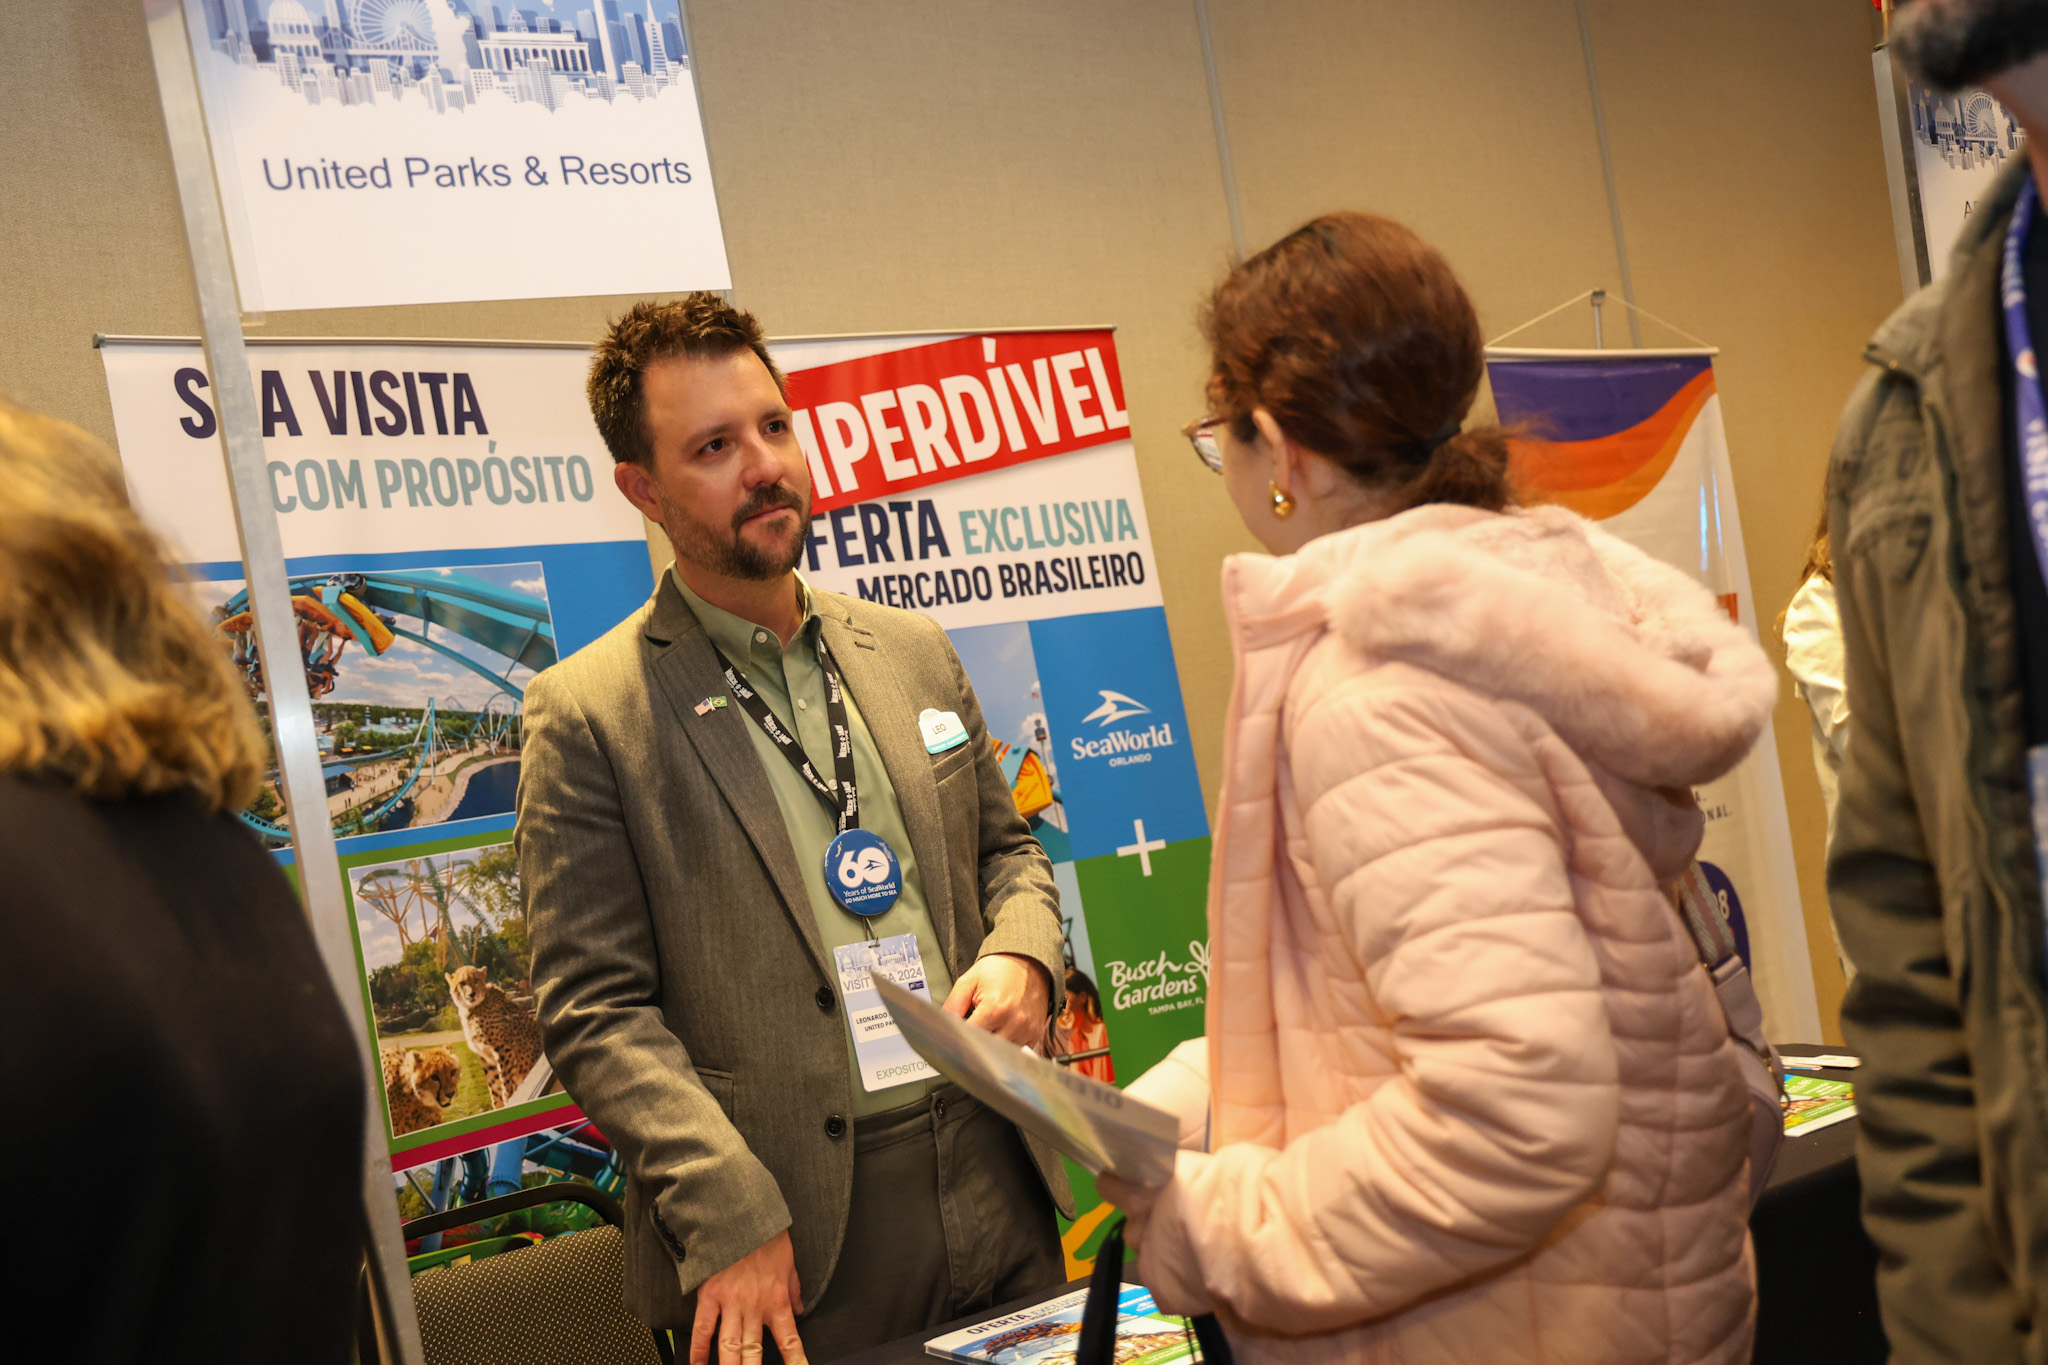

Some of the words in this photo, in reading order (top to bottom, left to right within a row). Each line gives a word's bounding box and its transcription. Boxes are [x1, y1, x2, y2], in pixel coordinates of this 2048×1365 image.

[262, 157, 392, 191] United
[404, 155, 512, 188] Parks
[524, 155, 549, 186] &
[559, 155, 692, 186] Resorts
[174, 367, 303, 439] SA
[307, 369, 489, 437] VISITA
[791, 336, 1130, 500] MPERDÍVEL
[266, 459, 368, 513] COM
[373, 439, 595, 509] PROPÓSITO
[803, 499, 952, 572] FERTA
[958, 498, 1139, 555] EXCLUSIVA
[856, 565, 993, 609] MERCADO
[997, 551, 1146, 599] BRASILEIRO
[931, 723, 947, 735] LEO
[1070, 722, 1175, 761] SeaWorld
[1108, 752, 1153, 768] ORLANDO
[837, 846, 891, 889] 60
[843, 889, 860, 898] Years
[860, 886, 868, 895] of
[867, 881, 896, 893] SeaWorld
[842, 976, 870, 992] VISIT
[897, 966, 923, 982] 2024
[1104, 950, 1184, 988] Busch
[1113, 973, 1198, 1011] Gardens
[1148, 1002, 1176, 1016] TAMPA
[856, 1011, 888, 1025] LEONARDO
[864, 1022, 885, 1032] UNITED
[885, 1019, 897, 1027] PAR
[966, 1313, 1031, 1335] OFERTA
